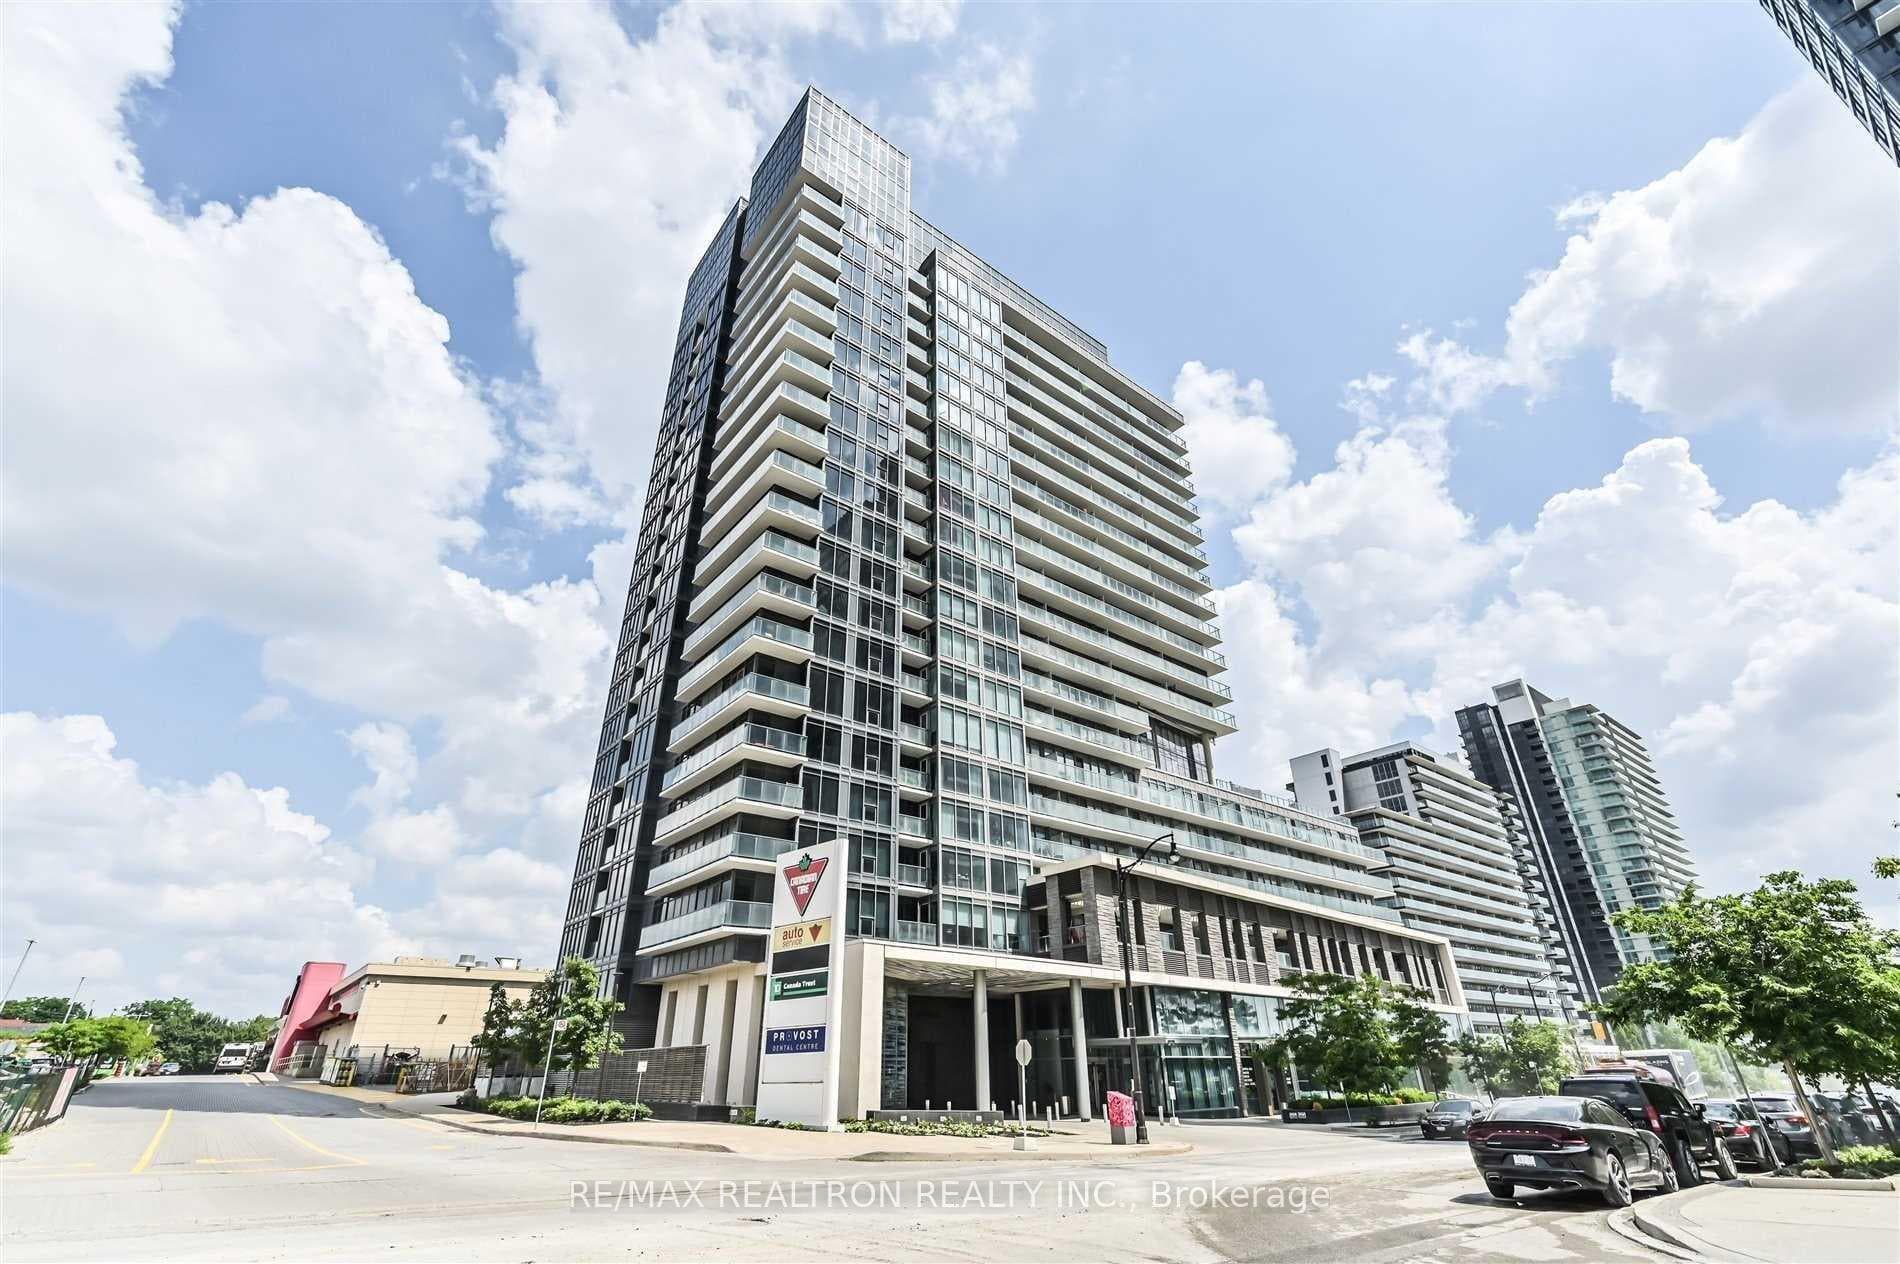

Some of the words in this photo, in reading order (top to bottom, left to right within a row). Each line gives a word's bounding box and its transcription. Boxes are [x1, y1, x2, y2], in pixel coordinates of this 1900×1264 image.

[782, 927, 804, 940] auto
[782, 938, 803, 948] service
[783, 982, 802, 990] Canada
[802, 980, 816, 988] Trust
